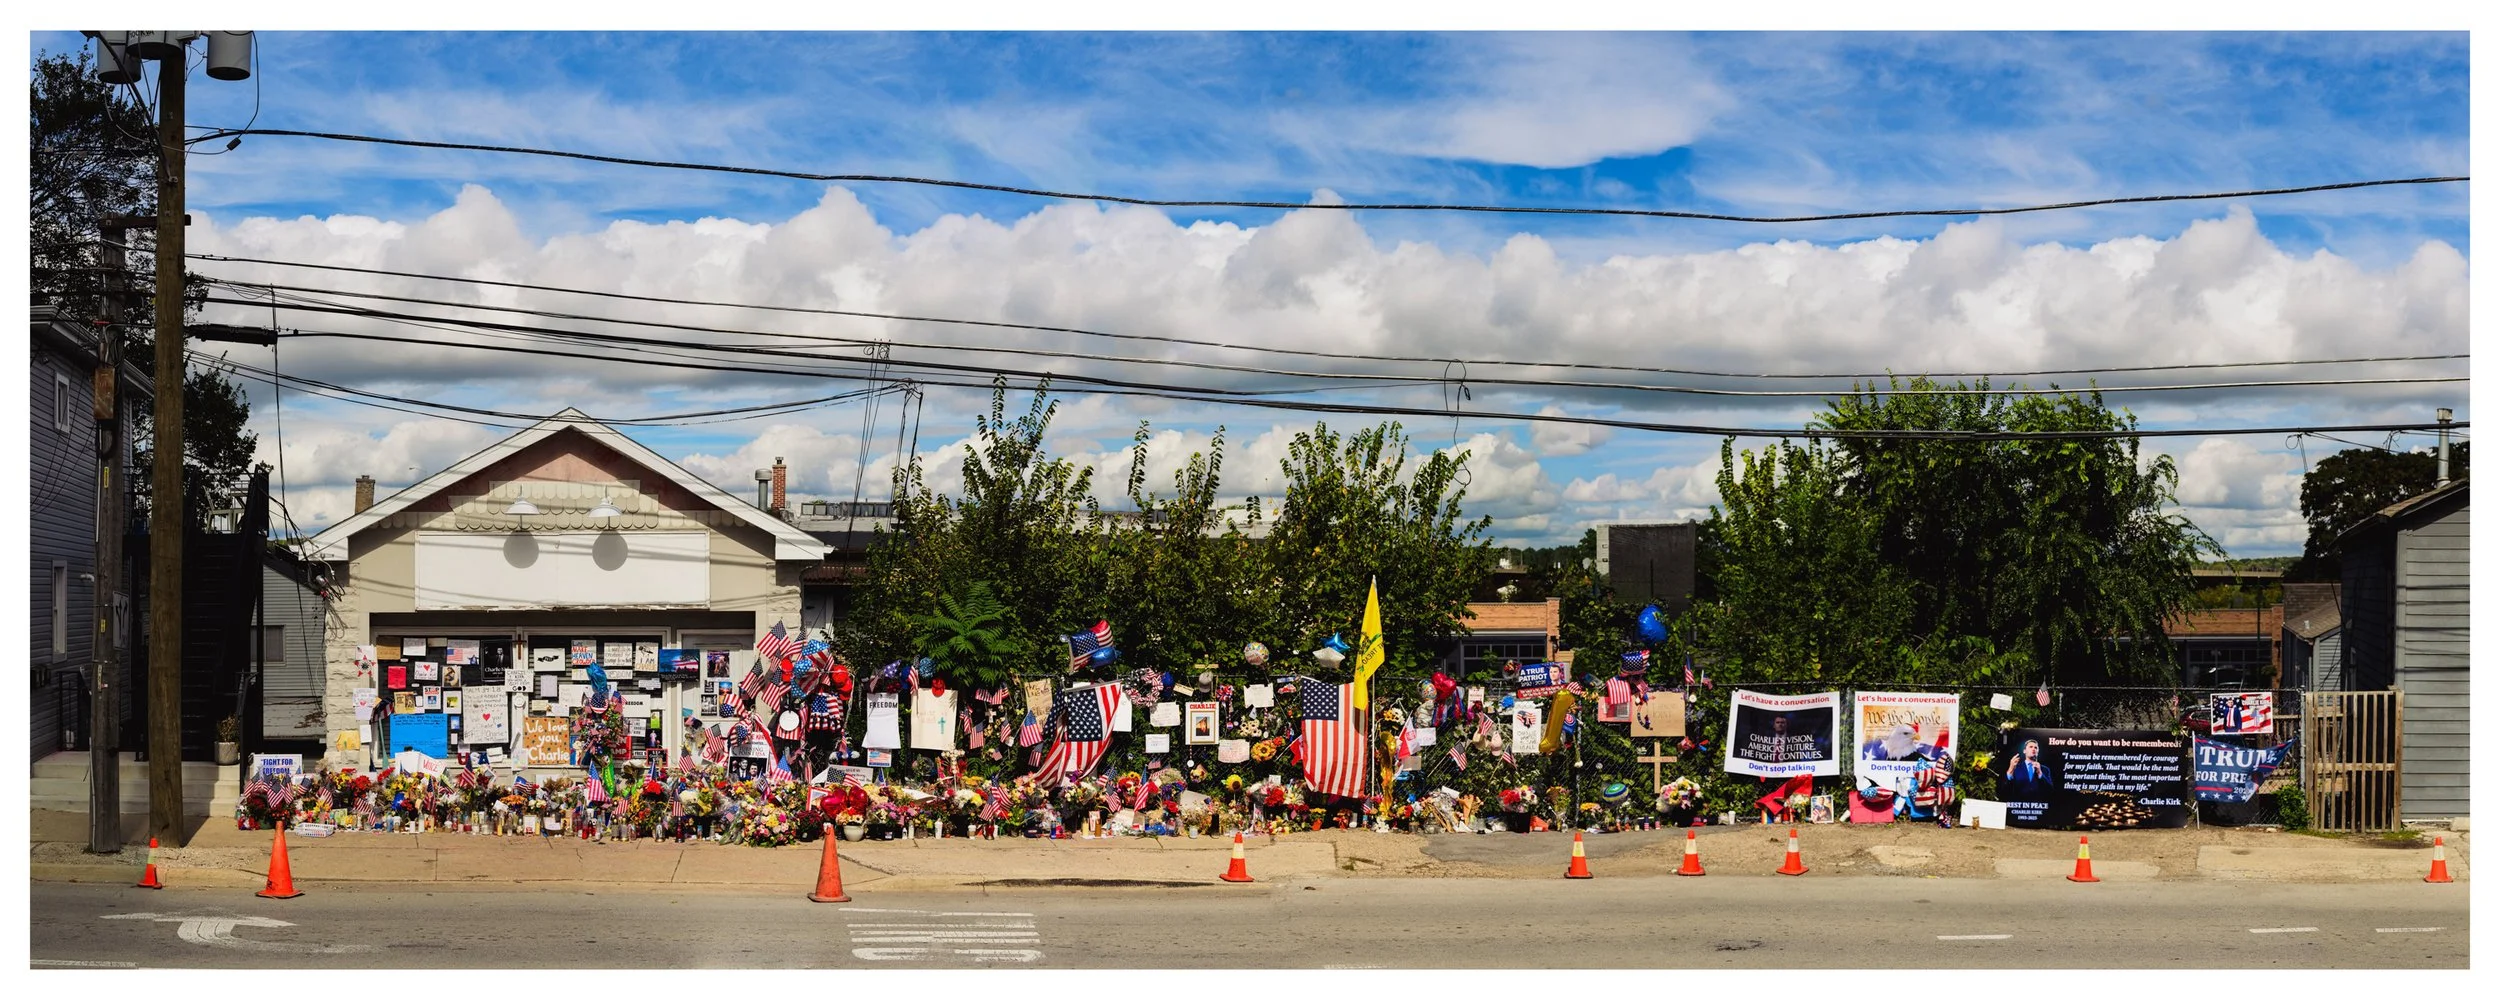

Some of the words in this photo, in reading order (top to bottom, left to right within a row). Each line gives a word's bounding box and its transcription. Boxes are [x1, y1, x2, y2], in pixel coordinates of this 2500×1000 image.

[1518, 673, 1547, 682] PATRIOT
[1741, 693, 1756, 702] Let's
[1756, 696, 1773, 705] have
[1780, 696, 1830, 706] conversation
[1904, 696, 1957, 704] conversation
[1866, 710, 1886, 725] We
[1904, 710, 1941, 726] People
[526, 720, 544, 733] We
[547, 721, 568, 731] love
[1749, 733, 1785, 744] CHARLIE'S
[1787, 734, 1815, 743] VISION.
[2048, 737, 2066, 746] How
[2067, 738, 2077, 746] do
[2078, 740, 2092, 748] you
[1748, 742, 1785, 752] AMERICA'S
[1786, 743, 1816, 752] FUTURE.
[528, 746, 570, 761] Charlie
[1741, 749, 1755, 757] THE
[1755, 751, 1777, 761] FIGHT
[1777, 750, 1823, 761] CONTINUES.
[2141, 754, 2152, 763] for
[2152, 755, 2178, 763] courage
[2200, 746, 2277, 770] TRUM
[1749, 763, 1769, 772] Don't
[1770, 765, 1786, 773] stop
[1788, 763, 1816, 772] talking
[1894, 764, 1911, 773] stop
[2063, 762, 2074, 771] for
[2085, 762, 2104, 771] faith.
[2064, 773, 2097, 781] important
[2098, 773, 2117, 782] thing.
[2148, 774, 2181, 782] important
[2195, 771, 2218, 782] FOR
[2064, 782, 2081, 791] thing
[2099, 783, 2116, 791] faith
